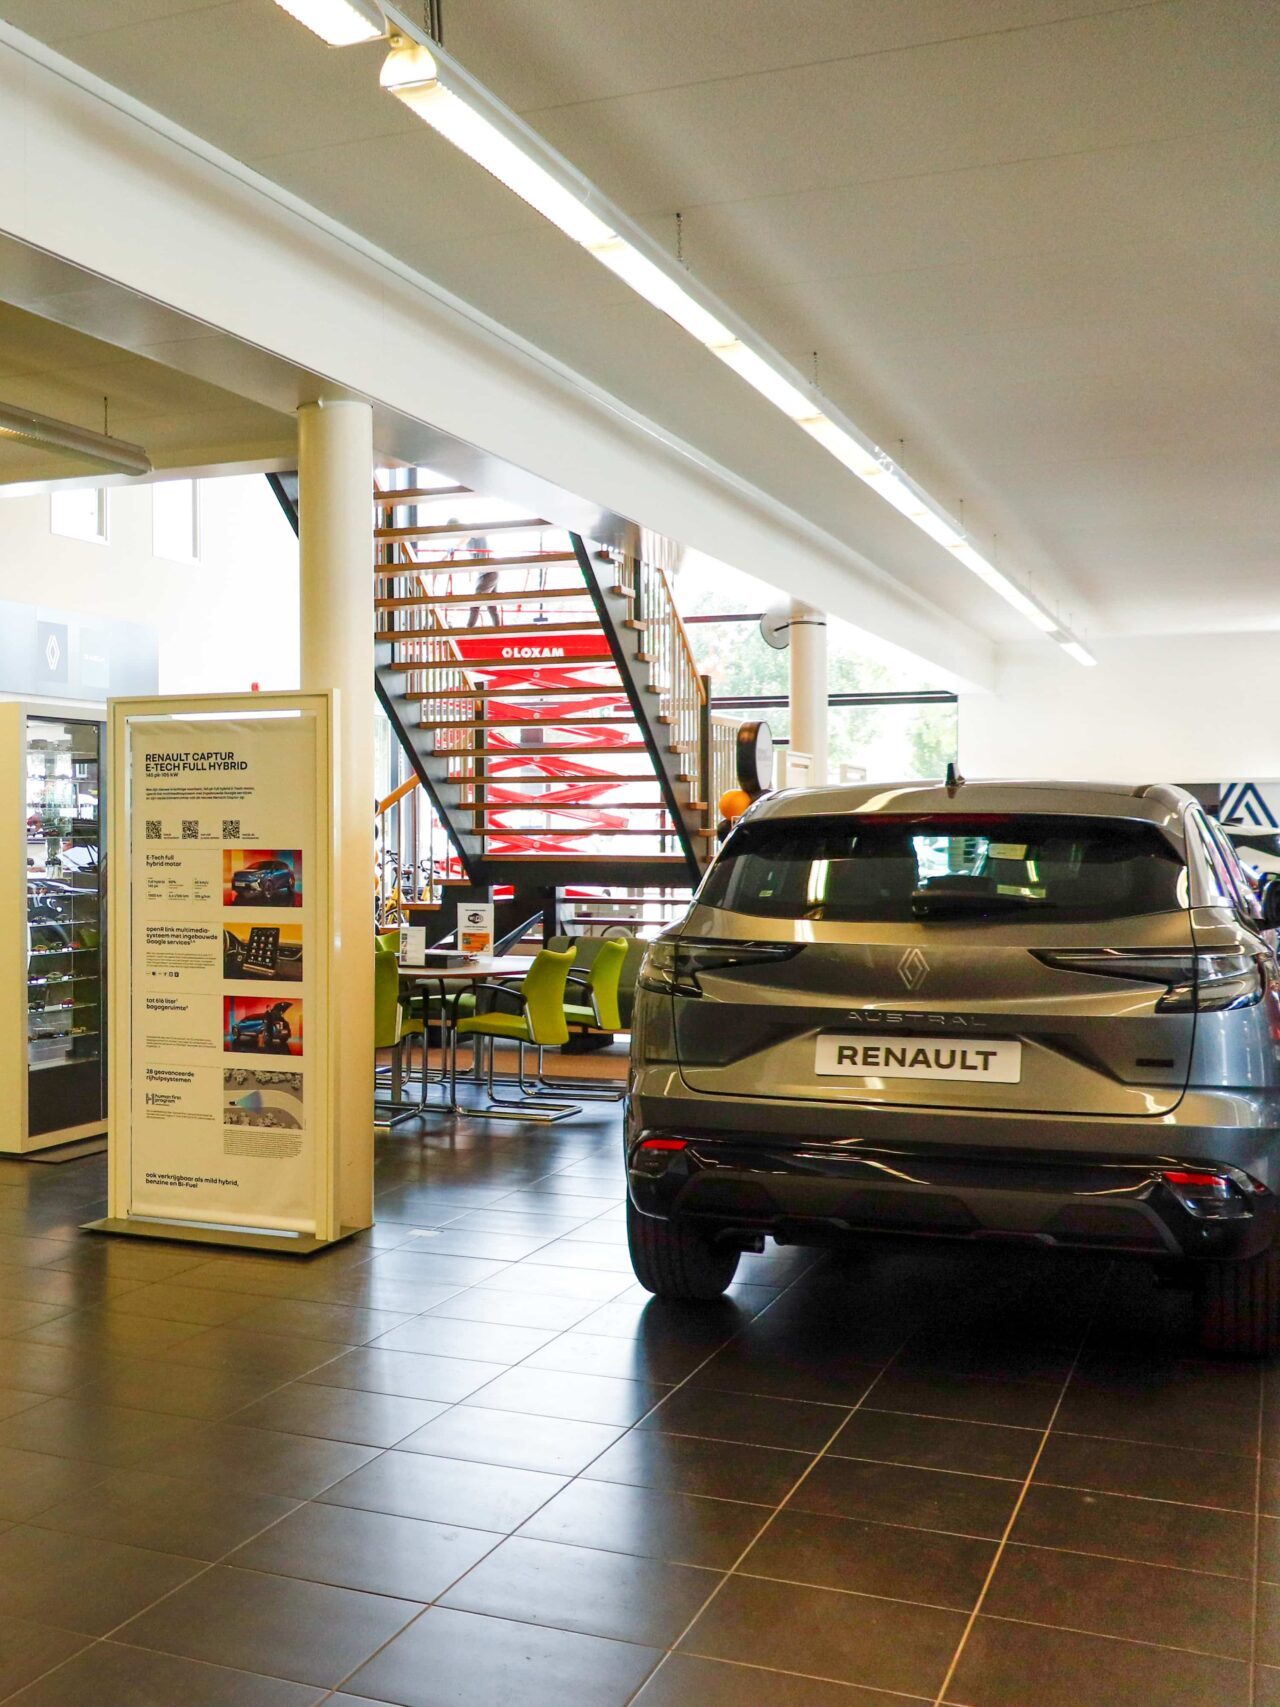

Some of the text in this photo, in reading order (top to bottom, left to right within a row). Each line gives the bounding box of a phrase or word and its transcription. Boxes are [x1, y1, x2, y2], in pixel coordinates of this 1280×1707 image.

[513, 647, 565, 658] LOXAM
[145, 751, 234, 762] RENAULT CAPTUR
[145, 761, 248, 772] E-TECH FULL HYBRID
[847, 1011, 987, 1027] AUSTRAL
[837, 1045, 998, 1071] RENAULT
[146, 1075, 192, 1083] rijhulpsystemen
[158, 1173, 194, 1182] verkrijgbaar
[218, 1178, 239, 1187] hybrid,
